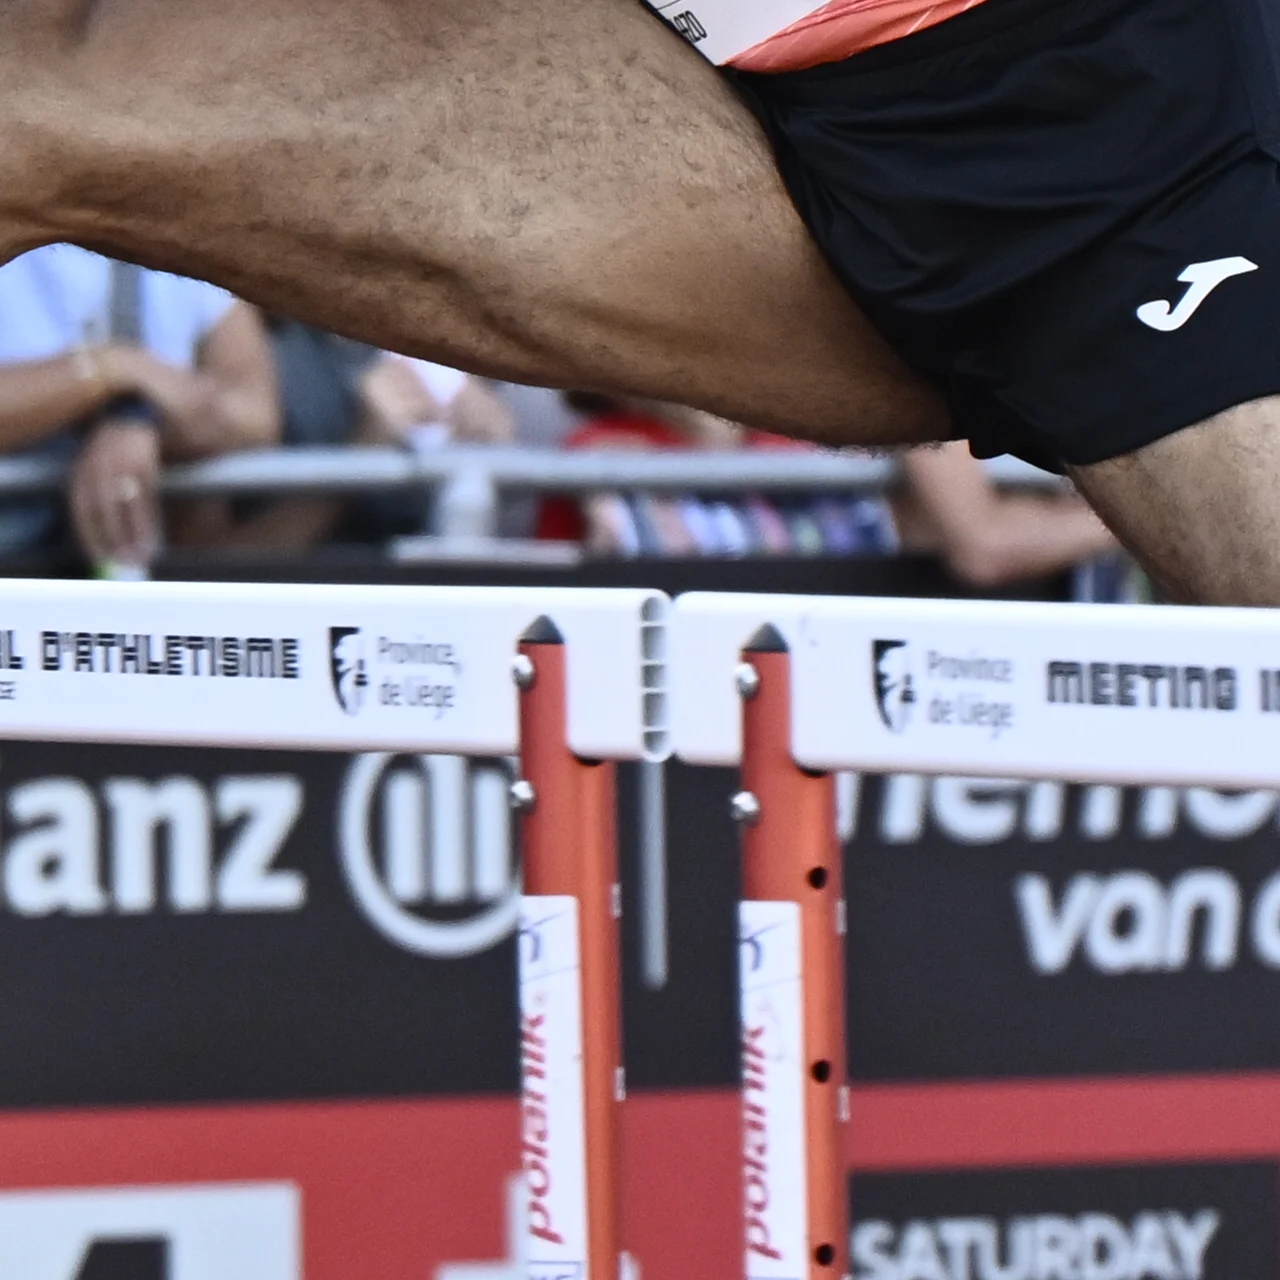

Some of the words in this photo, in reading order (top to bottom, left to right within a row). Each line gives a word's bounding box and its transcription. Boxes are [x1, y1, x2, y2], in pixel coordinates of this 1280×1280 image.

[39, 629, 300, 679] D'ATHLETISME
[378, 632, 453, 666] Province
[926, 650, 1013, 683] Province
[1046, 660, 1237, 711] MEETING
[1017, 867, 1243, 975] van
[850, 1207, 1220, 1280] SATURDAY
